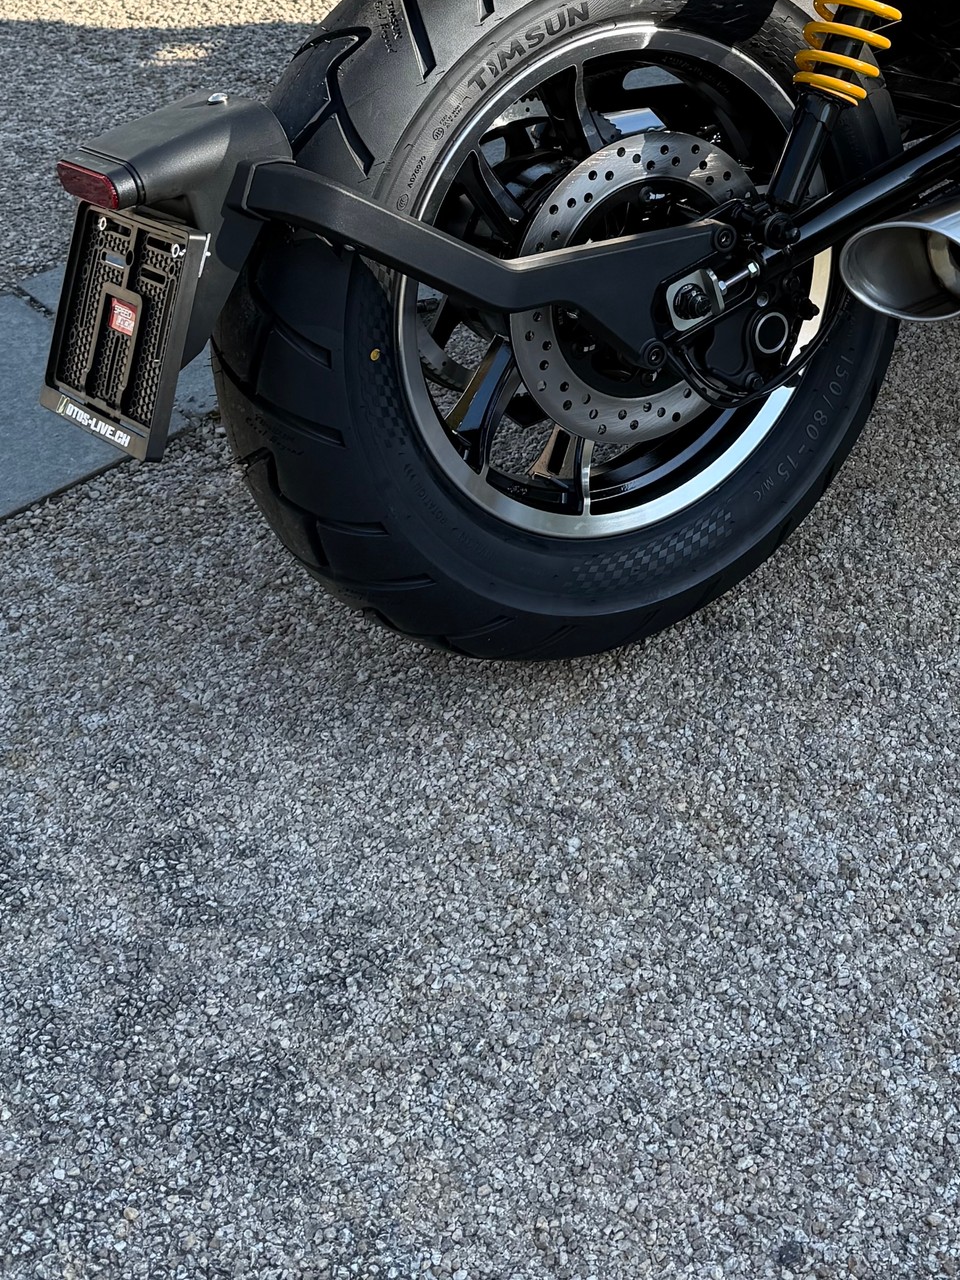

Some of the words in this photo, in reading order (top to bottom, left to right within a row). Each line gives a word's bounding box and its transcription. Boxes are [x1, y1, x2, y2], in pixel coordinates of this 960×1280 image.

[468, 1, 590, 91] TIMSUN
[113, 304, 133, 320] SPEED
[753, 477, 775, 502] M/C
